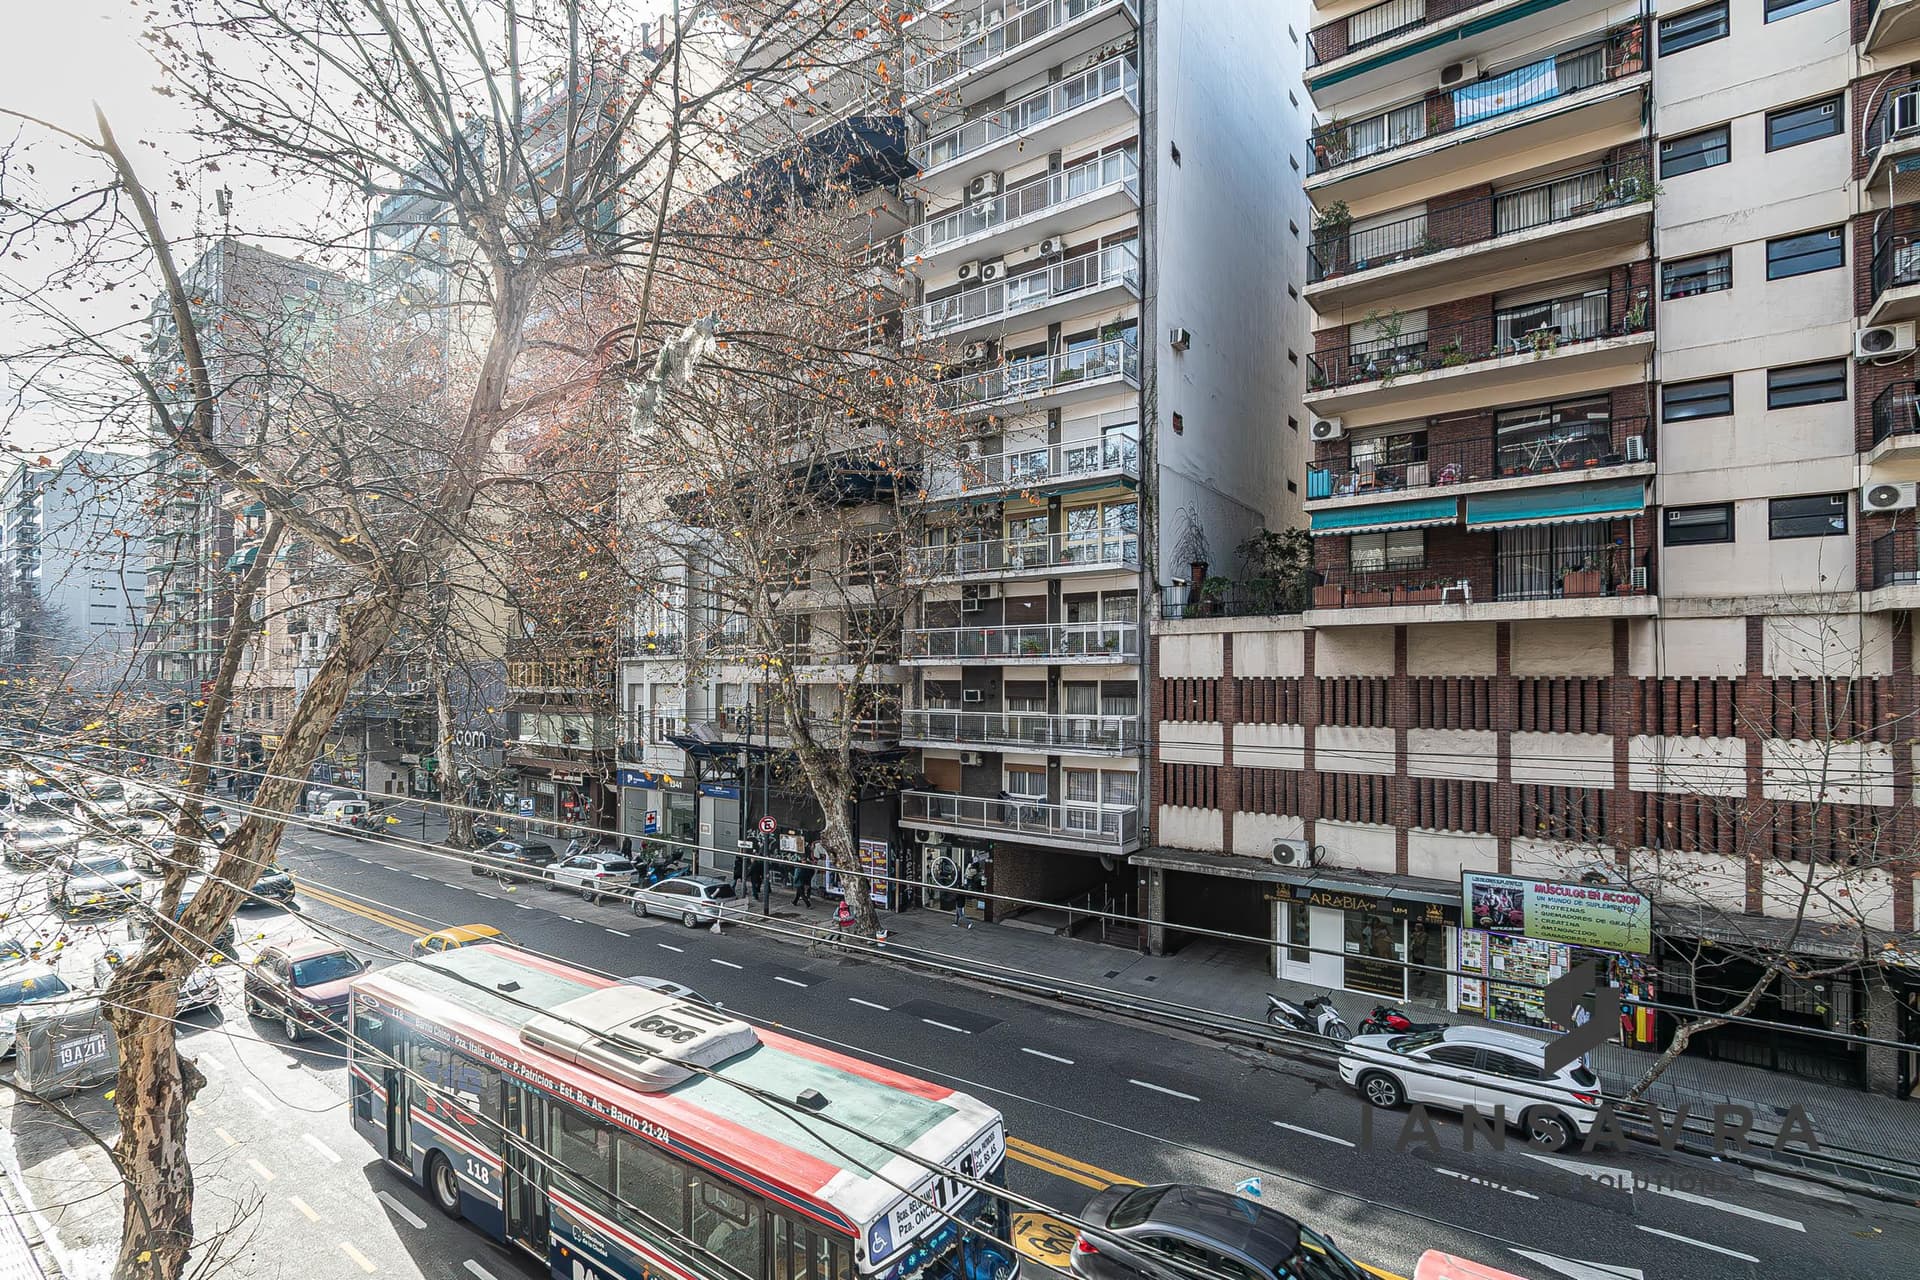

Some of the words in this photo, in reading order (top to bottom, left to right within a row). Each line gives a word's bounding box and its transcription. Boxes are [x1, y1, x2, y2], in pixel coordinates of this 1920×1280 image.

[1587, 890, 1600, 901] EN
[1540, 903, 1586, 914] PROTEINAS
[1548, 897, 1573, 906] MUNDO
[1573, 899, 1584, 907] DE
[1585, 901, 1637, 914] SUPLEMENTOS
[1540, 911, 1593, 922] QUEMADORES
[1540, 918, 1580, 928] CREATINA
[1541, 925, 1597, 937] AMINOACIDOS
[1540, 932, 1587, 943] GANADORES
[75, 1046, 83, 1061] A
[469, 1041, 486, 1058] Italia
[490, 1052, 508, 1068] Once
[521, 1065, 553, 1090] Patricios
[559, 1082, 576, 1100] Est.
[577, 1090, 590, 1106] Bs.
[591, 1097, 605, 1113] As.
[610, 1105, 640, 1129] Barrio
[641, 1120, 670, 1144] 21-24
[466, 1159, 489, 1185] 118
[898, 1222, 915, 1238] Pza.
[914, 1206, 935, 1225] ONCE
